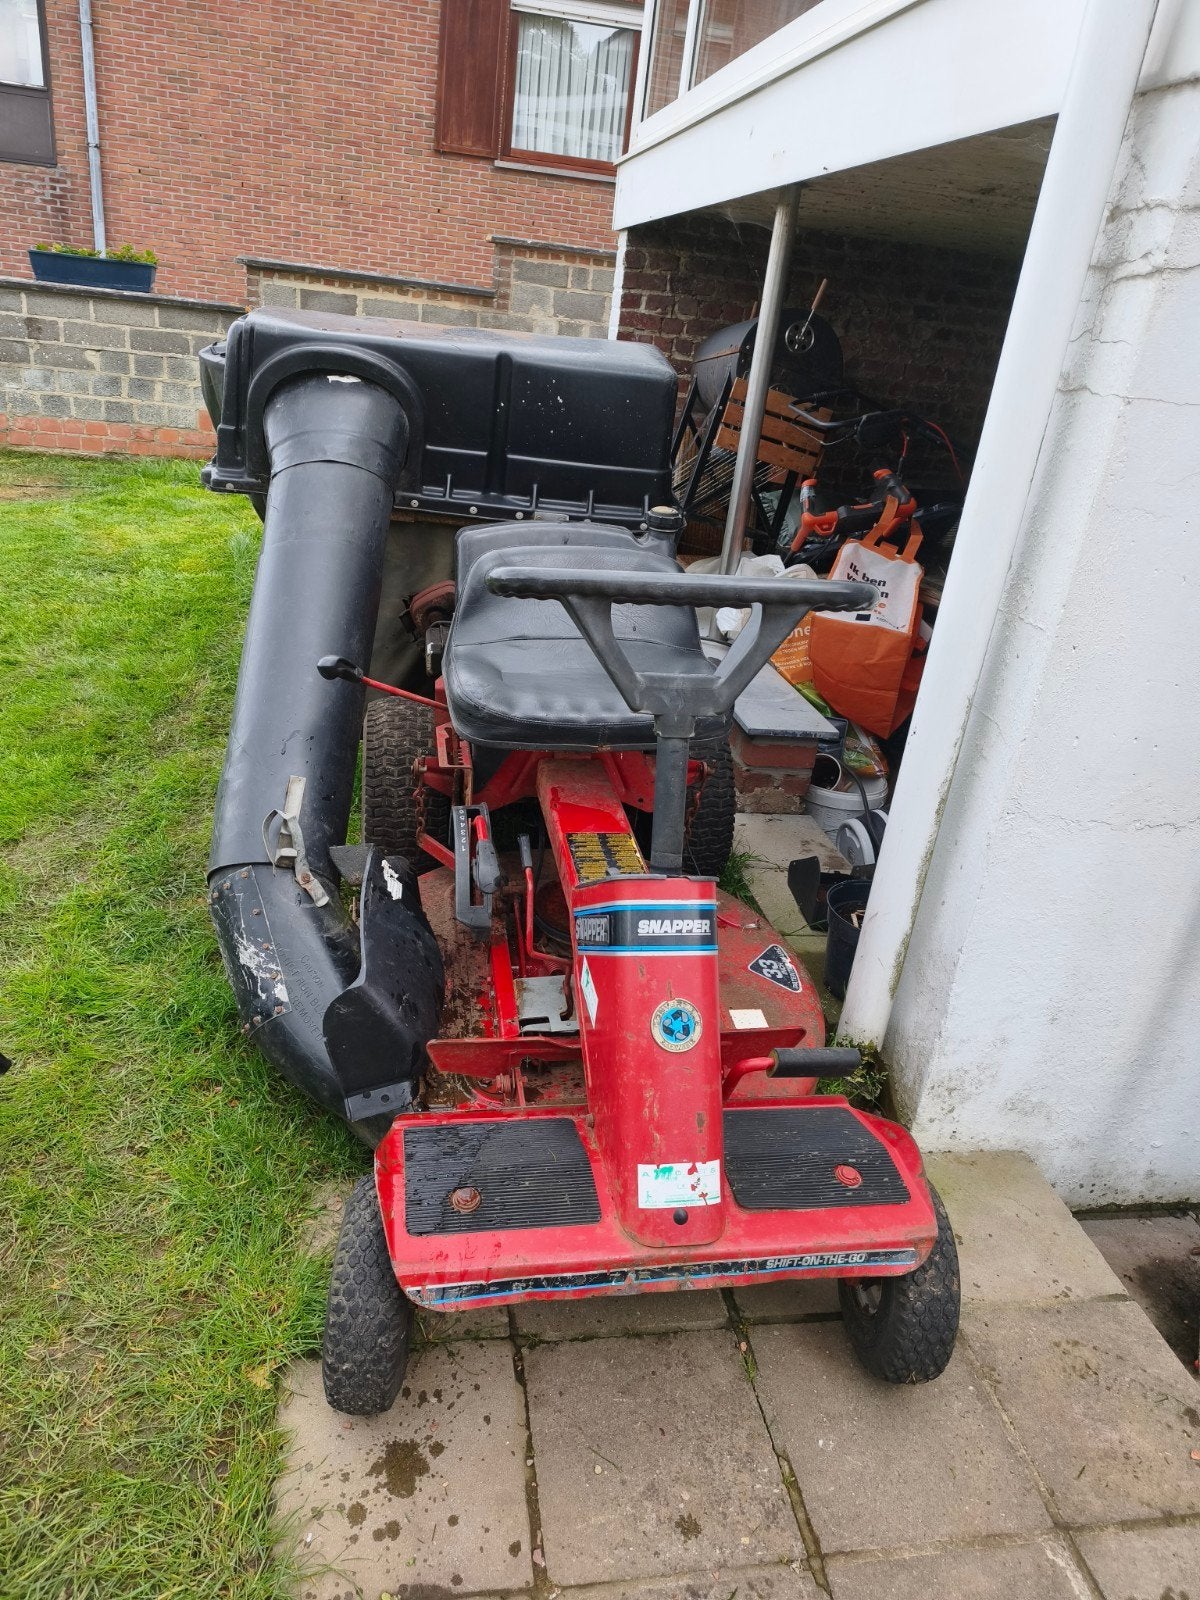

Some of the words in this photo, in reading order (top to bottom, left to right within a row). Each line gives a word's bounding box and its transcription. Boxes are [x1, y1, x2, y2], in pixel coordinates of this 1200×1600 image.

[862, 573, 887, 587] ben
[576, 917, 608, 942] SNAPPER
[638, 919, 711, 935] SNAPPER
[758, 958, 784, 979] 33
[766, 1253, 866, 1269] SHIFT-ON-THE-GO
